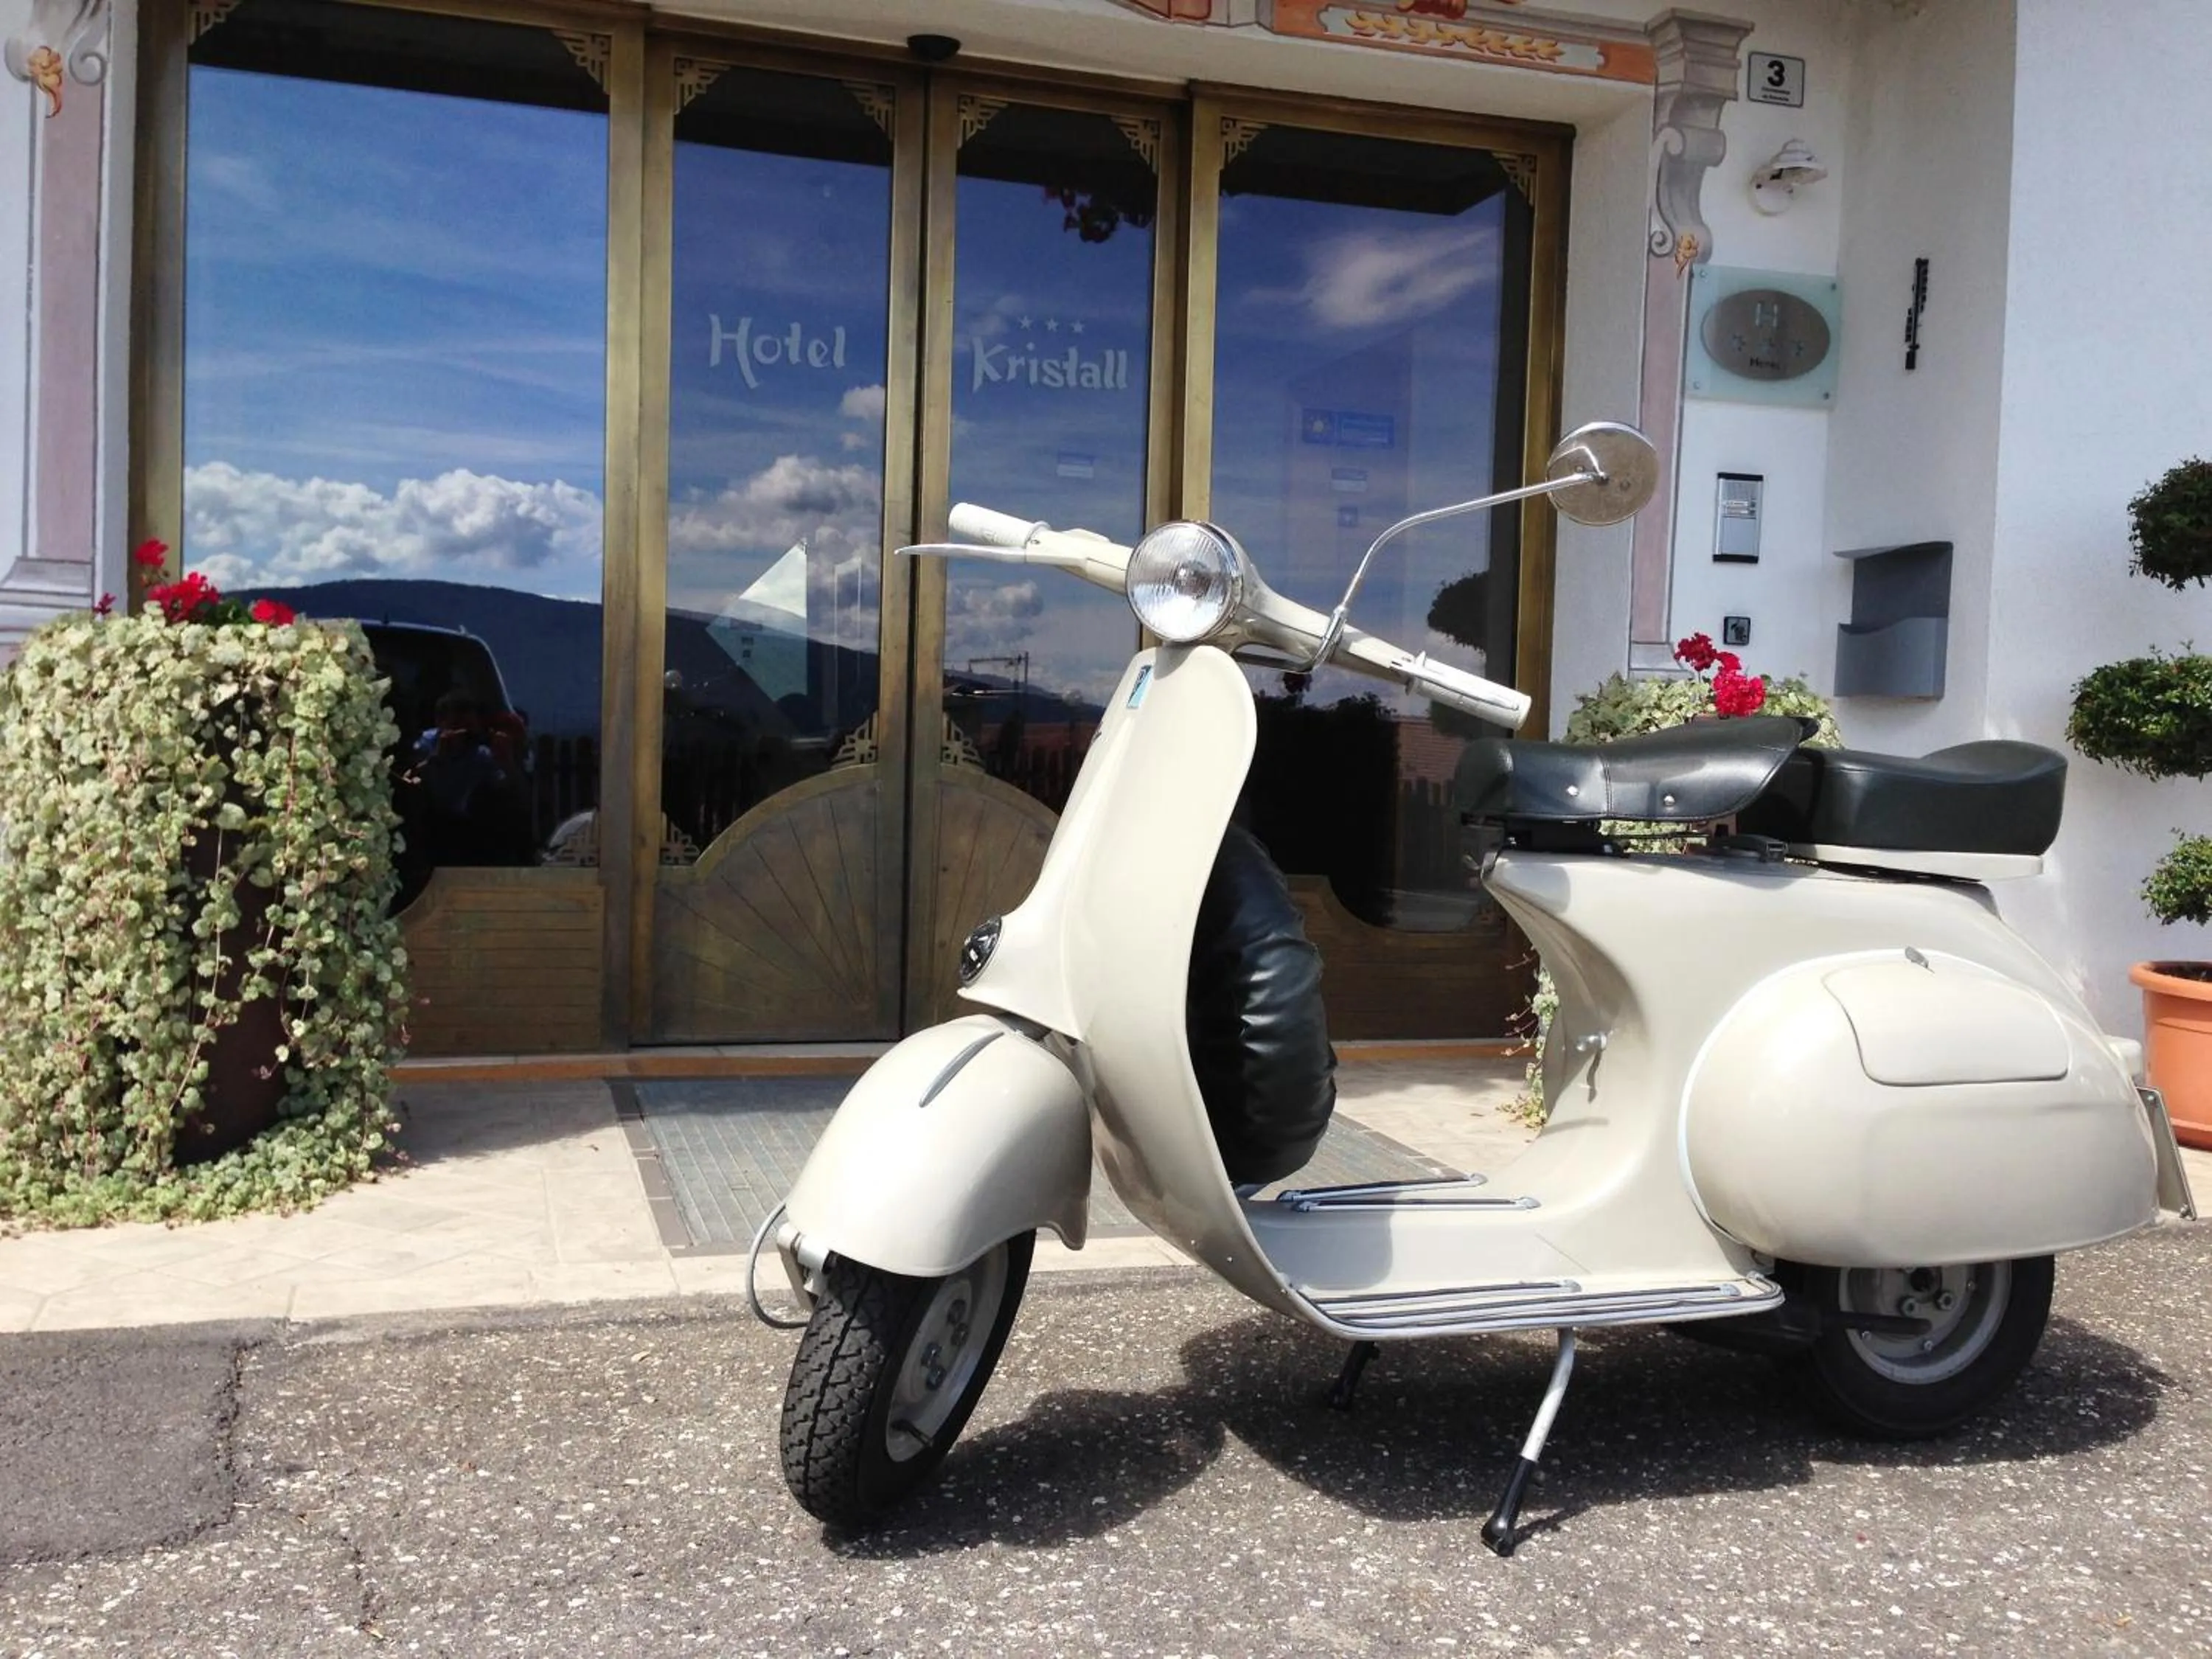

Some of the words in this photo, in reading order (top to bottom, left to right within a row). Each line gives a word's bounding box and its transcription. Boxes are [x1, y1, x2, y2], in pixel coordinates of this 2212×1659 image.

[1767, 60, 1785, 87] 3
[709, 313, 846, 389] Hotel
[971, 336, 1128, 394] Kristall
